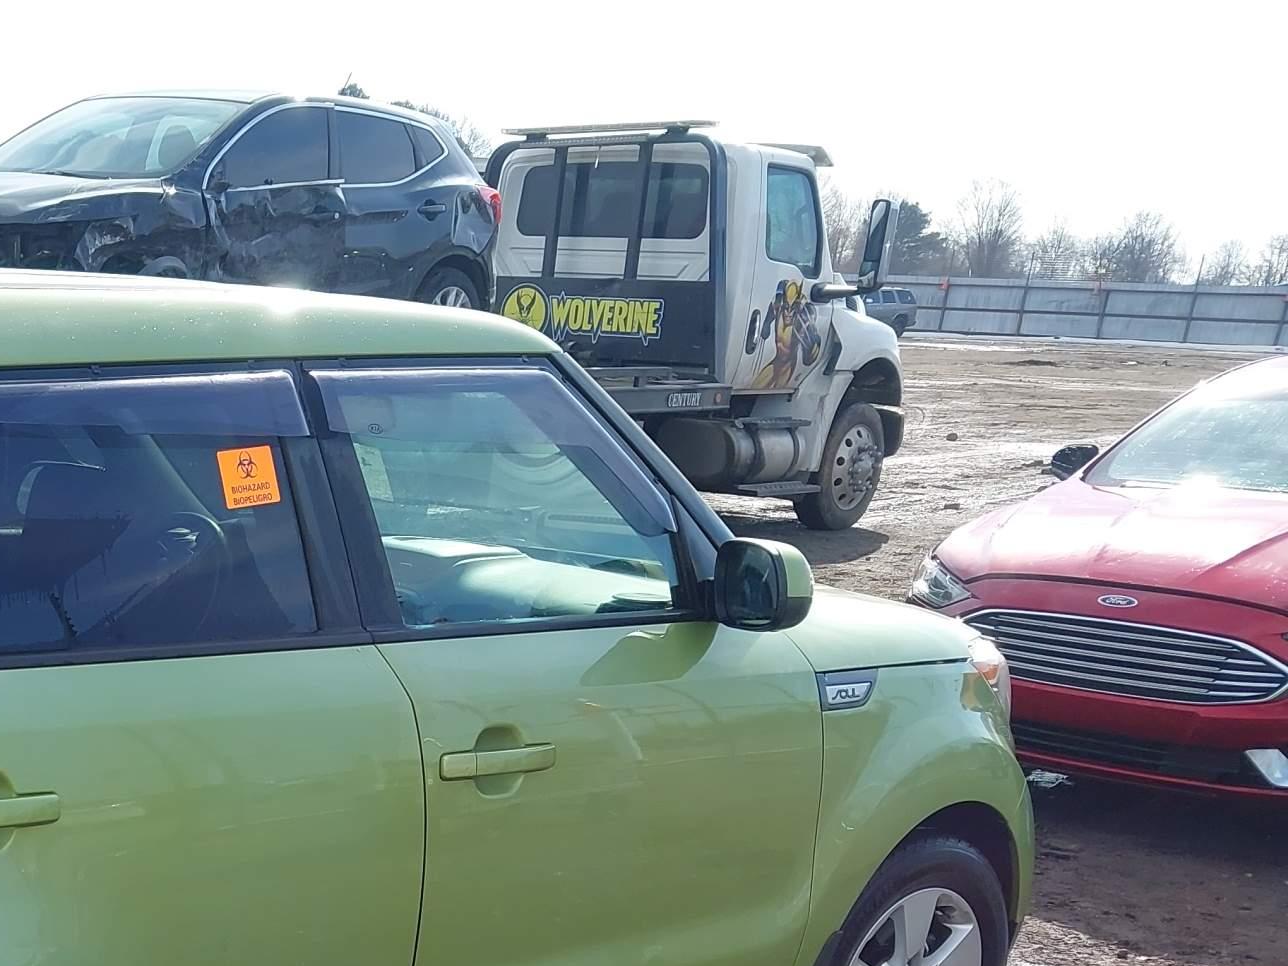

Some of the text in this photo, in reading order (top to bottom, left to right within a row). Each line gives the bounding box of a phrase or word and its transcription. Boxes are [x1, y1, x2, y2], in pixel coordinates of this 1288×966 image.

[550, 296, 663, 340] WOLVERINE
[668, 393, 702, 407] CENTURY
[231, 482, 271, 494] BIOHAZARD
[233, 492, 273, 505] BIOPELIGRO
